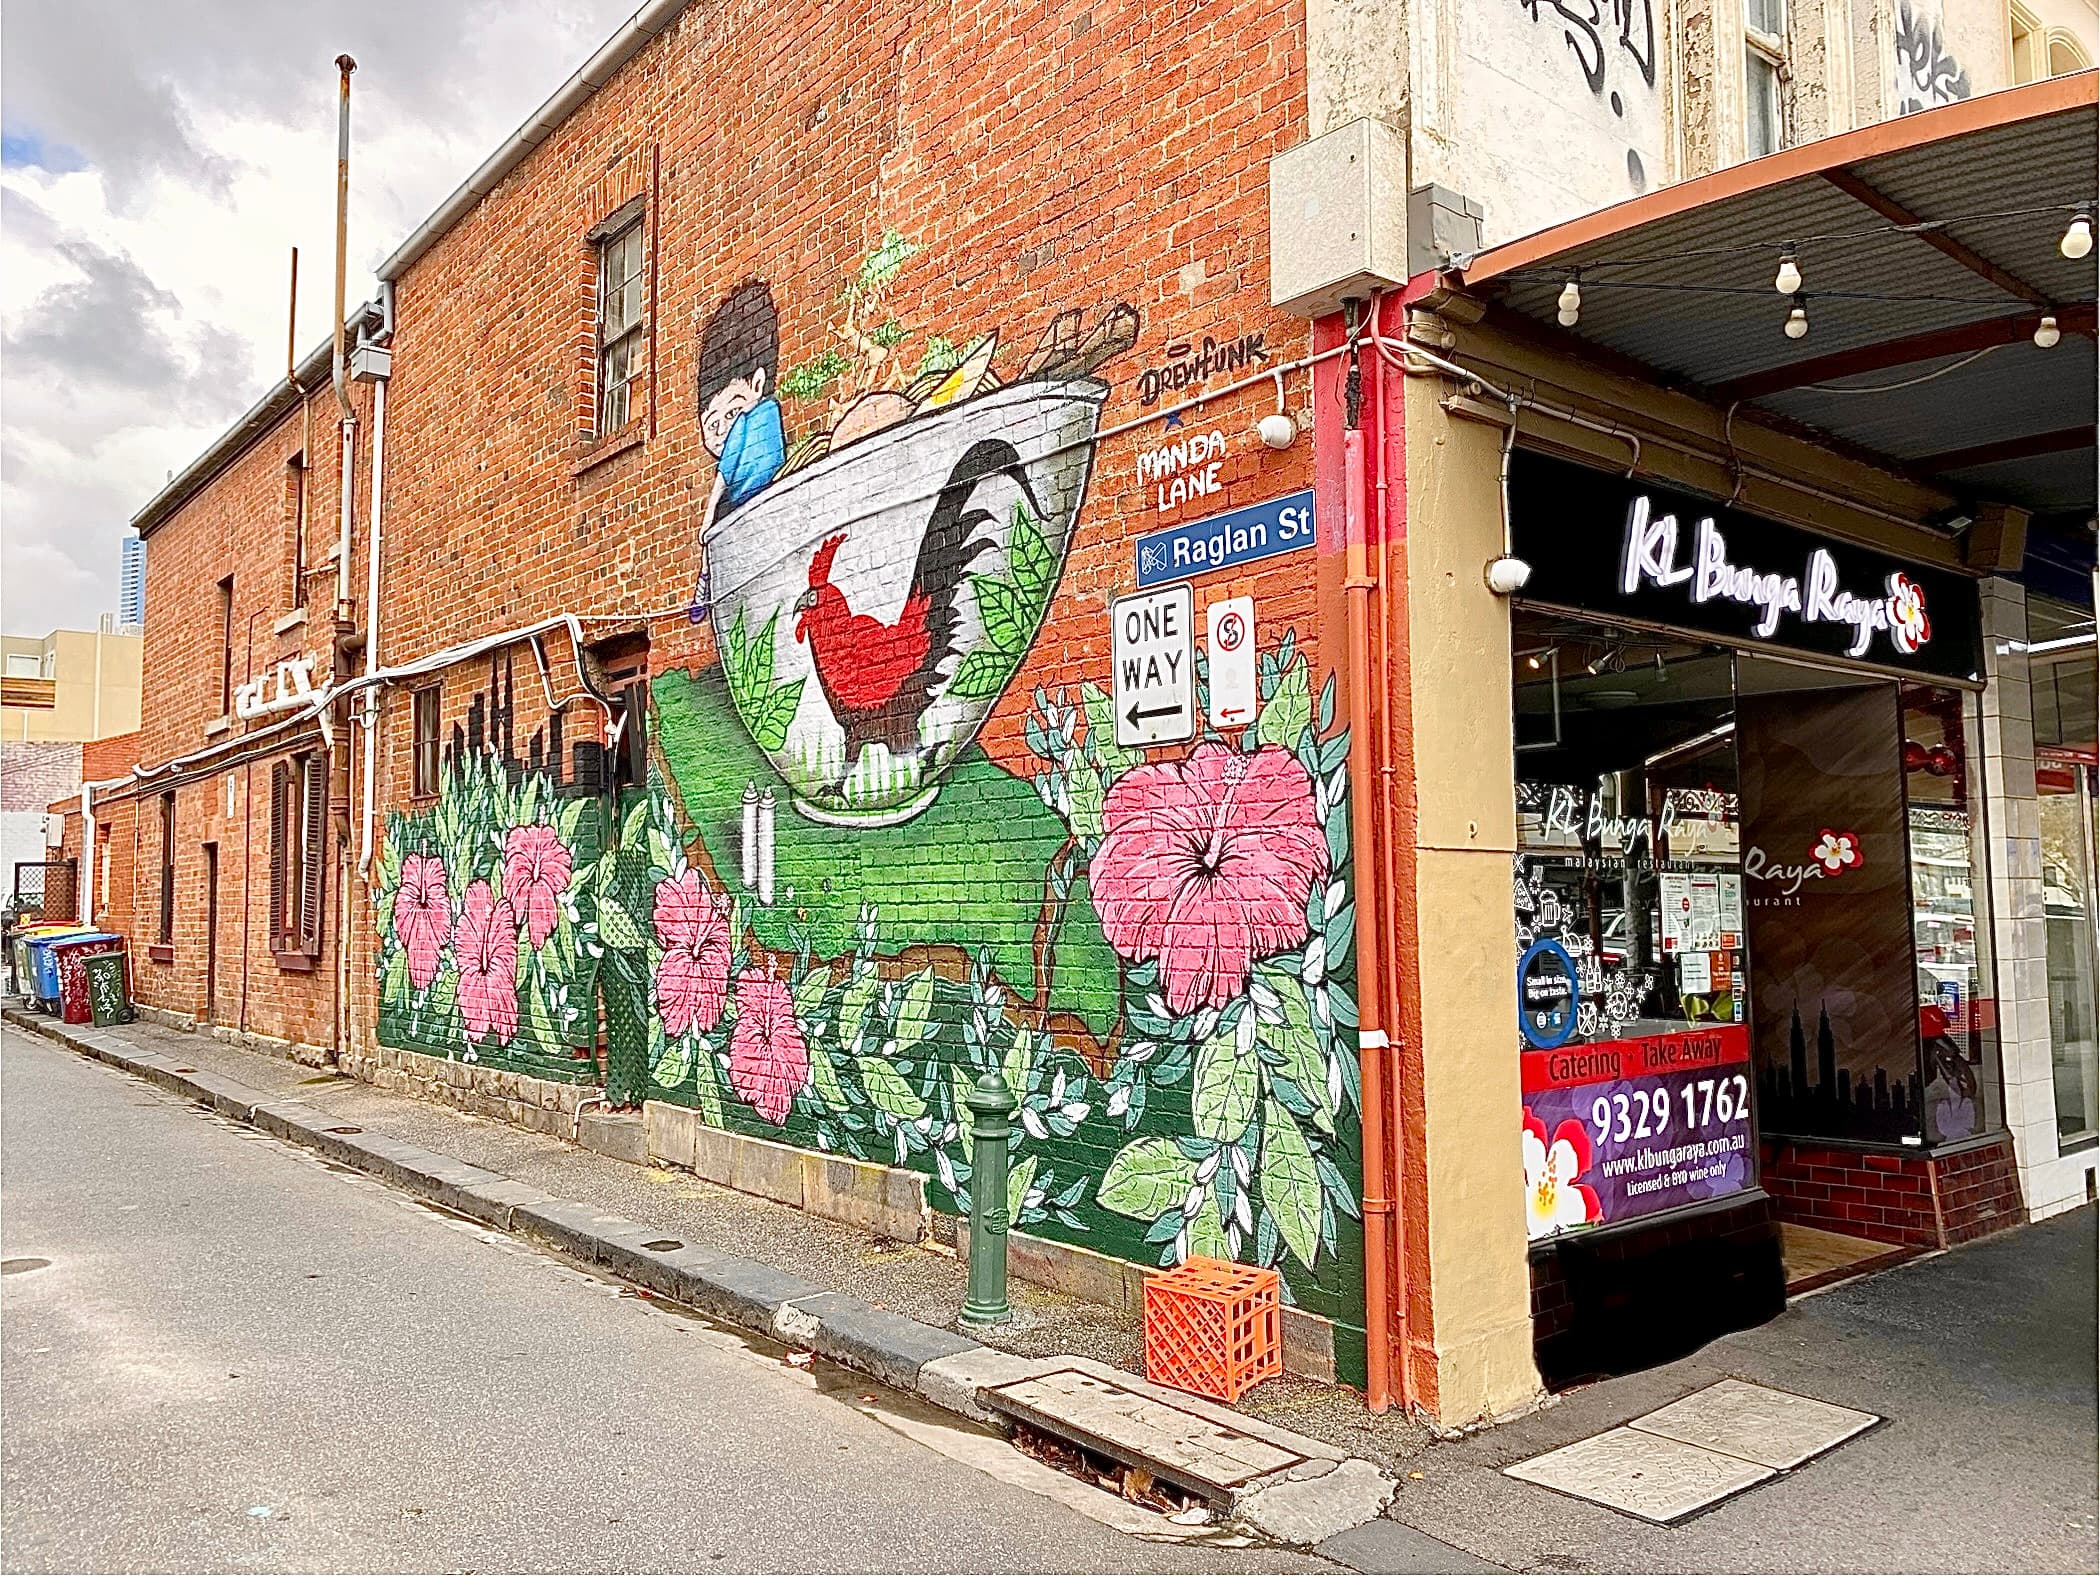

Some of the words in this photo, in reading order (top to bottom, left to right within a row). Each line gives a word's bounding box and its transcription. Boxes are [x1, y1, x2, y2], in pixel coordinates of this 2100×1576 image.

[1136, 430, 1226, 486] MANDA
[1158, 462, 1224, 512] LANE
[1173, 524, 1267, 569] Raglan
[1279, 506, 1311, 540] St
[1620, 496, 1694, 593] KL
[1693, 517, 1801, 637] Bunga
[1804, 549, 1889, 657] Raya
[1125, 602, 1179, 645] ONE
[1122, 652, 1182, 692] WAY
[1545, 787, 1584, 842] KL
[1587, 793, 1649, 854] Bunga
[1658, 797, 1708, 857] Raya
[1565, 857, 1626, 870] malaysian
[1745, 846, 1825, 895] Raya
[1550, 1050, 1621, 1080] Catering
[1642, 1042, 1676, 1067] Take
[1680, 1038, 1721, 1064] Away
[1592, 1086, 1670, 1147] 9329
[1681, 1074, 1749, 1130] 1762
[1602, 1134, 1745, 1178] www.klbungaraya.com.au
[1627, 1174, 1662, 1197] Licensed
[1664, 1174, 1671, 1187] &
[1672, 1169, 1687, 1184] BYO
[1689, 1166, 1708, 1181] wine
[1710, 1161, 1727, 1178] only
